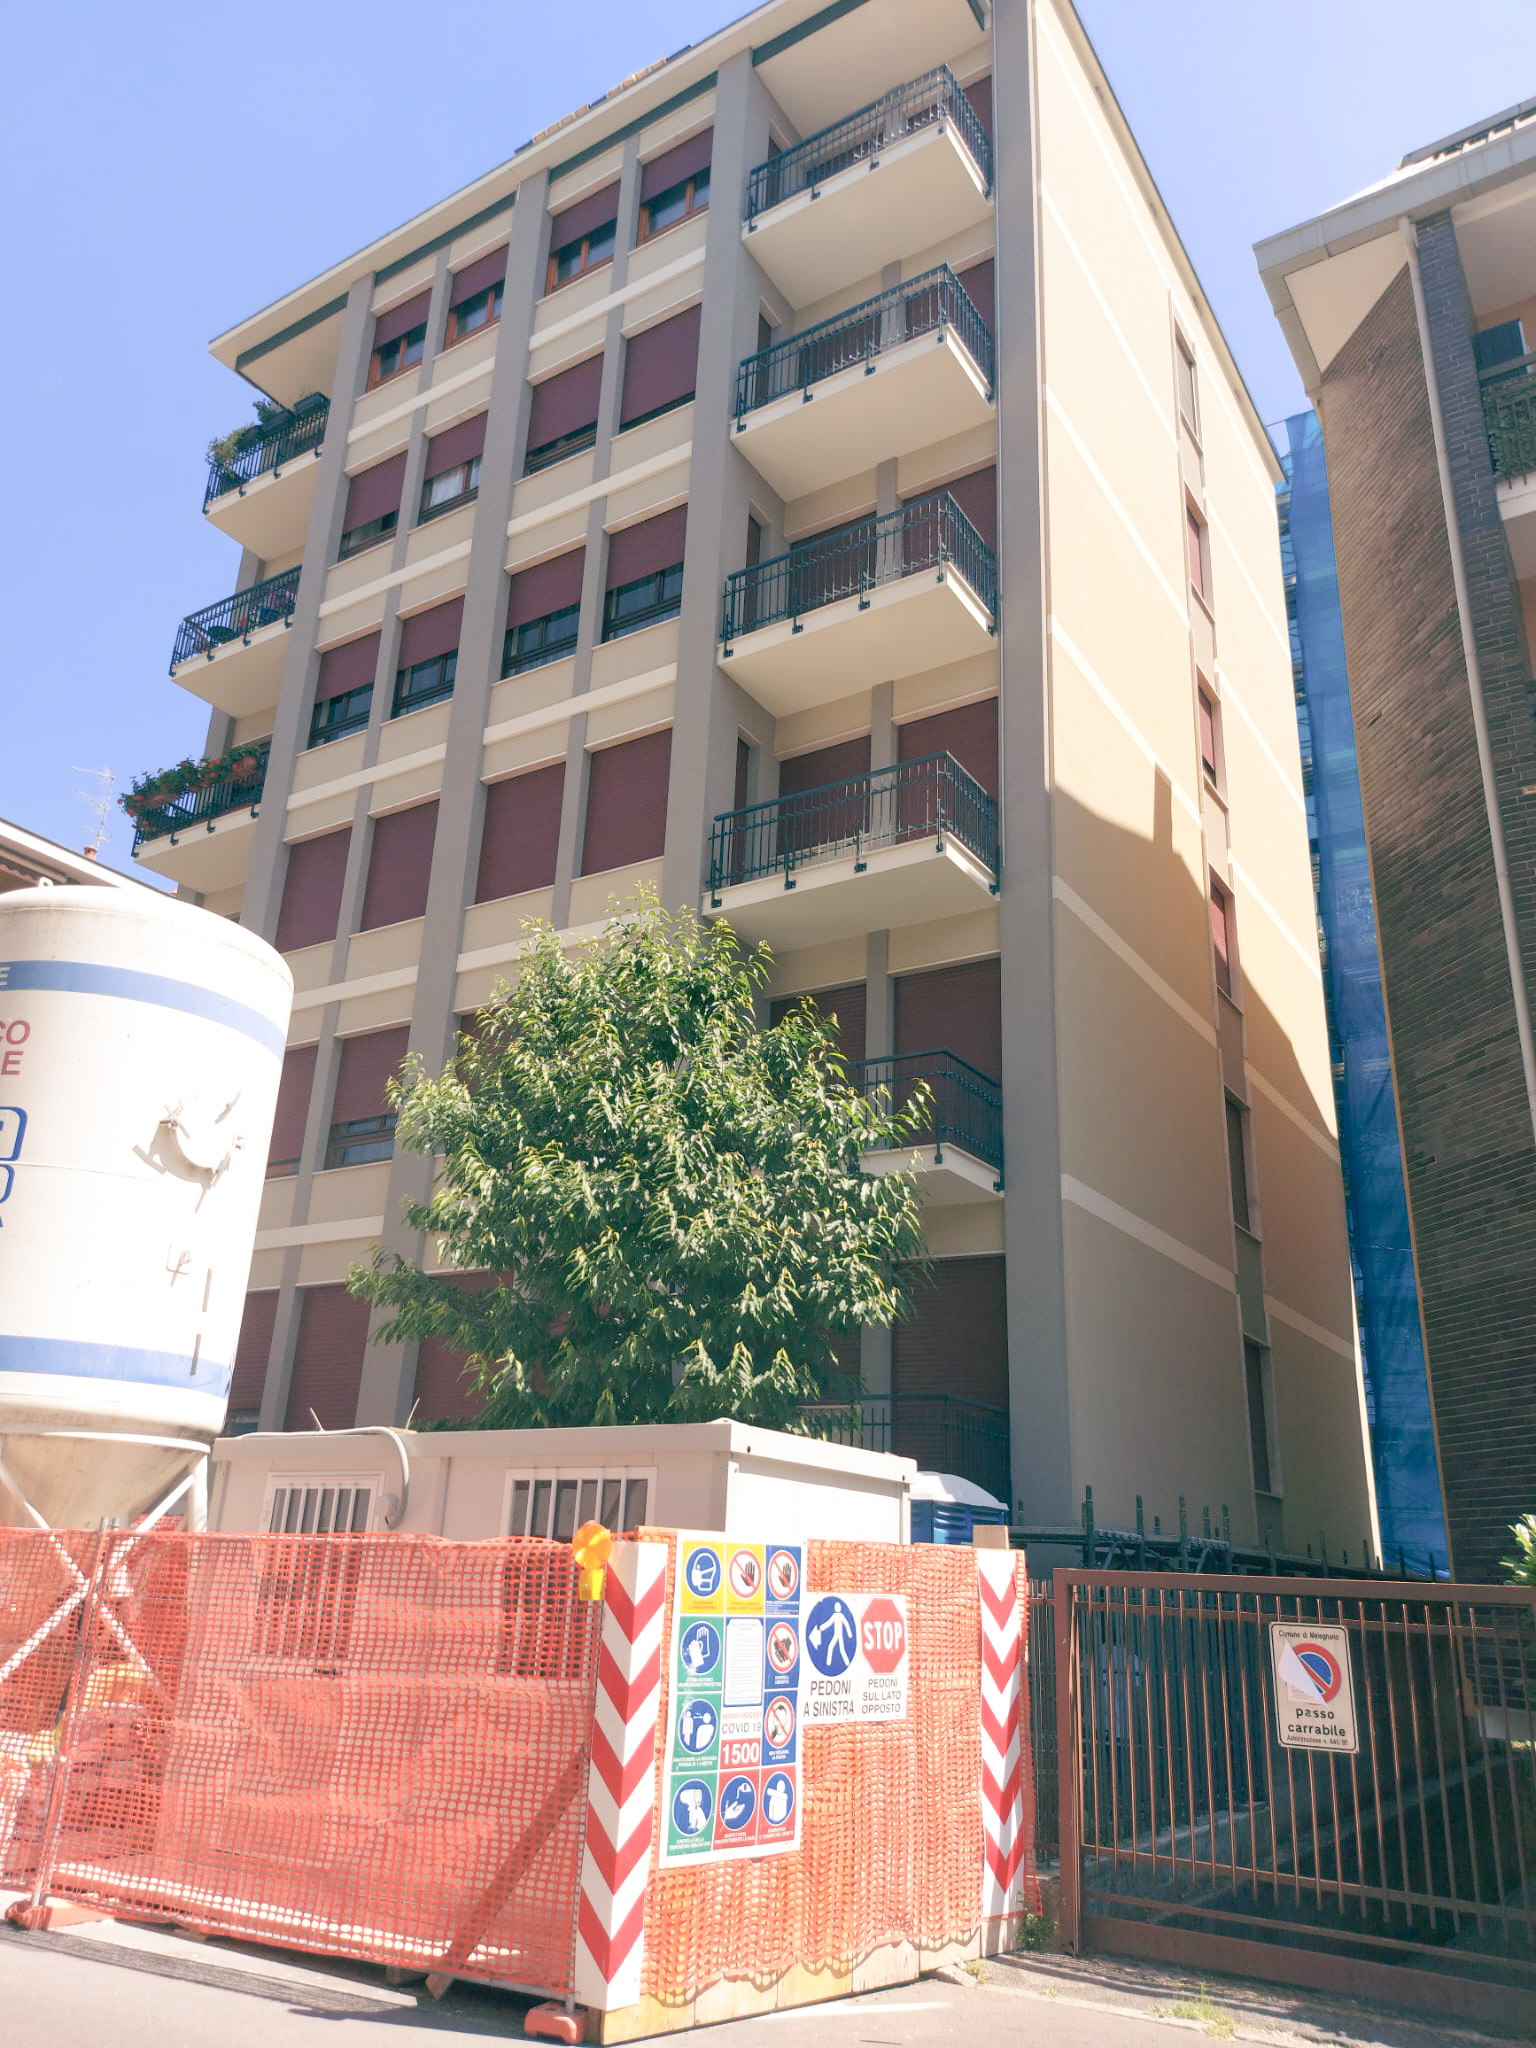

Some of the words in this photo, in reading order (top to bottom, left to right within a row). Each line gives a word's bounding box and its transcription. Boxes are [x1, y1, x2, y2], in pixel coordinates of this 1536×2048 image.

[863, 1621, 903, 1650] STOP
[1279, 1630, 1300, 1639] Comune
[810, 1680, 852, 1696] PEDONI
[868, 1678, 899, 1688] PEDONI
[862, 1691, 880, 1701] SUL
[881, 1690, 902, 1701] LATO
[803, 1701, 810, 1717] A
[812, 1699, 855, 1717] SINISTRA
[861, 1703, 901, 1714] OPPOSTO
[1296, 1708, 1335, 1720] passo
[721, 1722, 750, 1734] COVID
[753, 1721, 762, 1733] 19
[1287, 1723, 1346, 1737] carrabile
[722, 1742, 760, 1765] 1500
